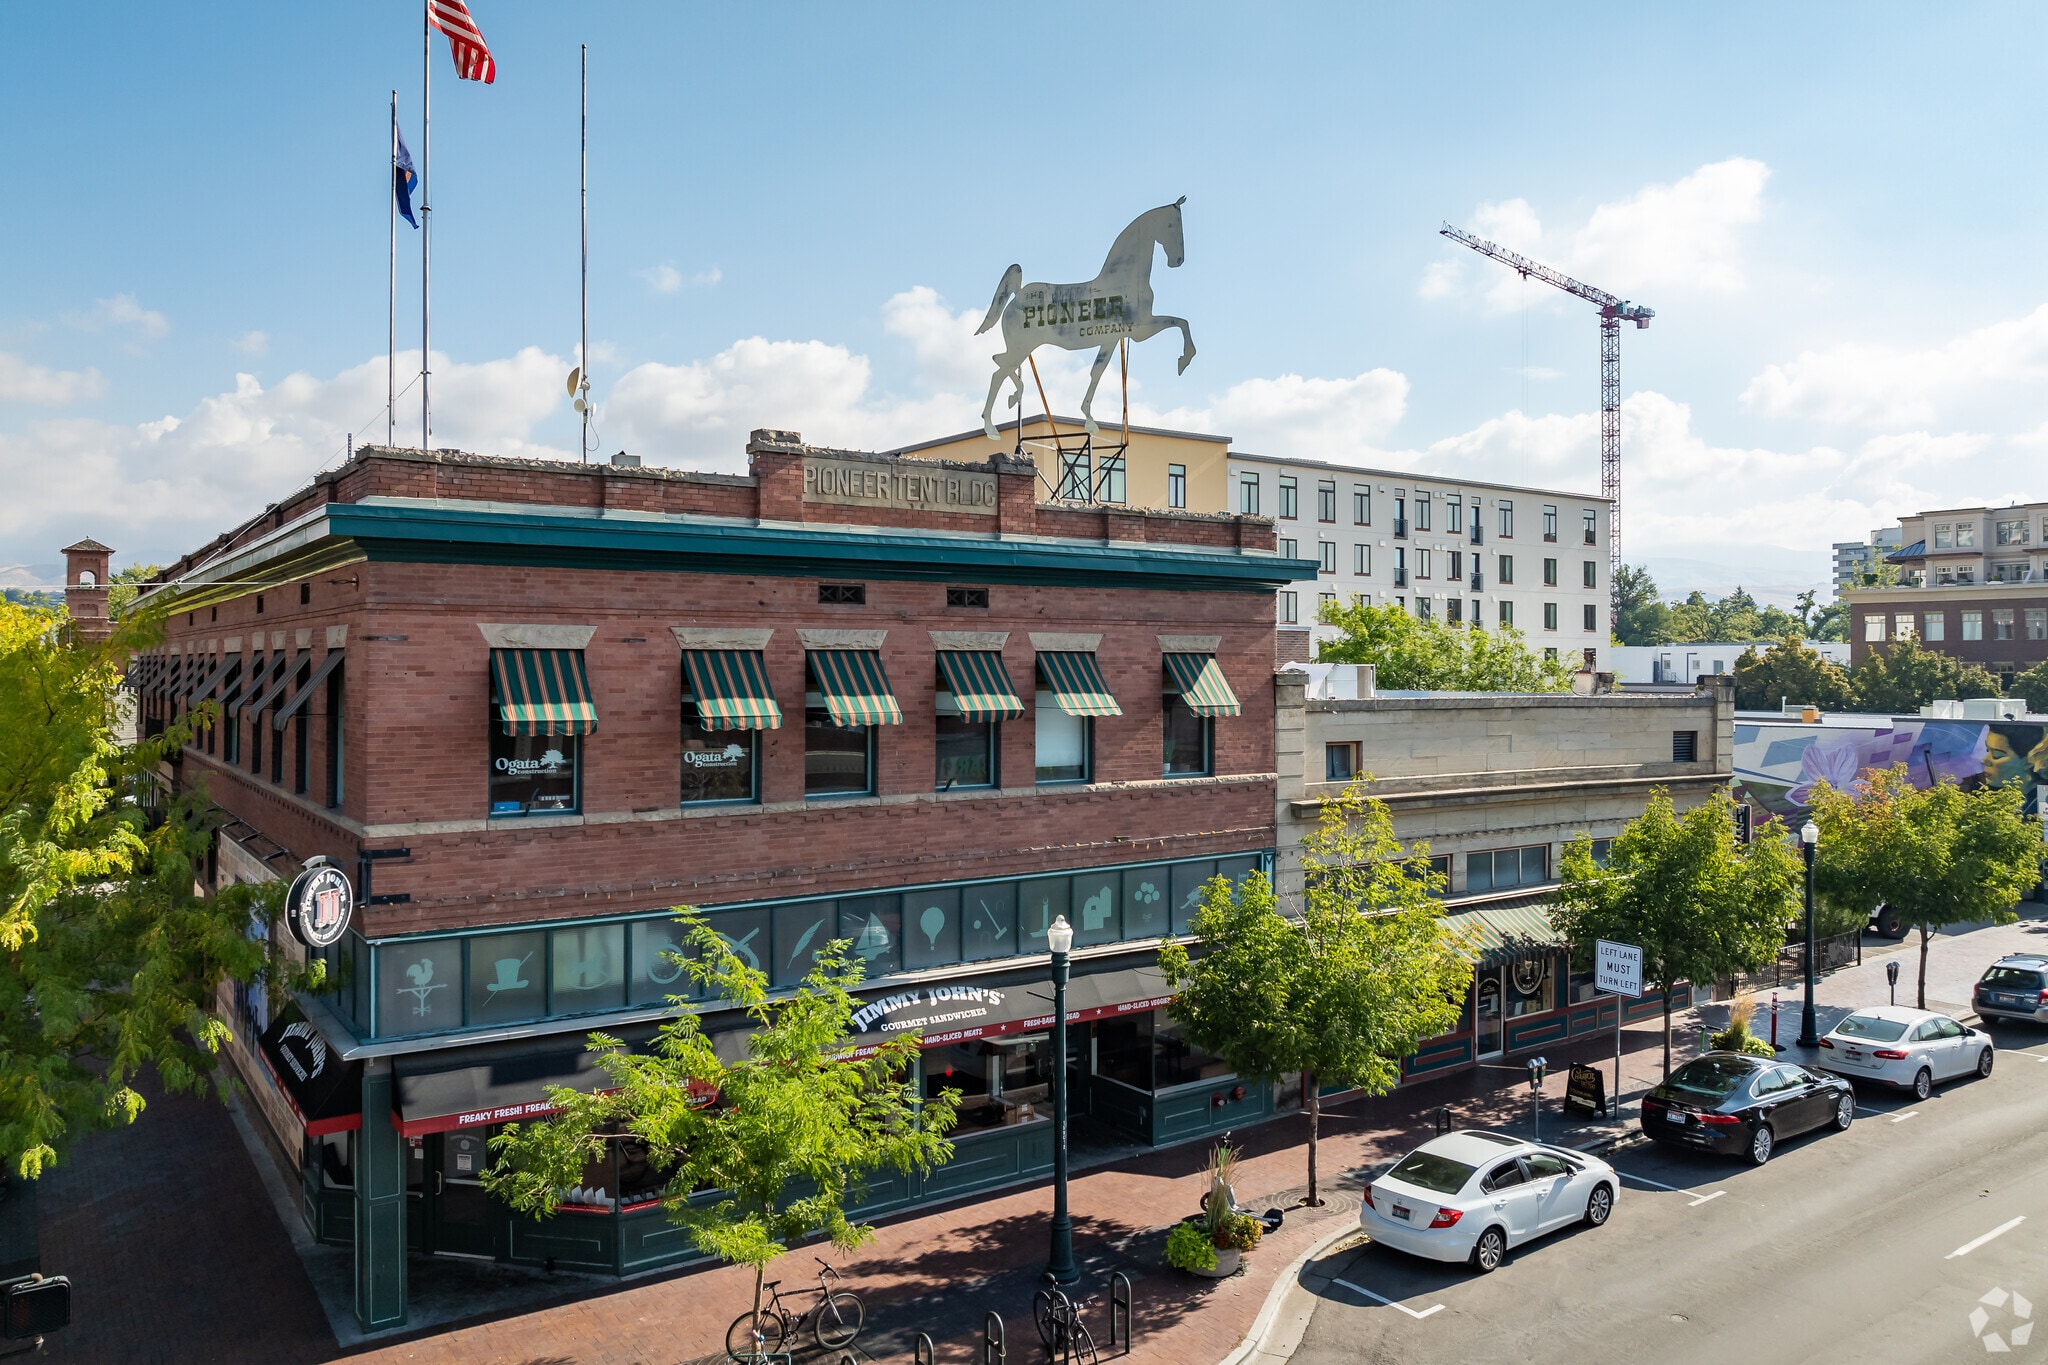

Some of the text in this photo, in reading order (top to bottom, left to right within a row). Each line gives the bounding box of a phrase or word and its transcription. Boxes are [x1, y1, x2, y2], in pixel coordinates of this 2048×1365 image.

[1022, 295, 1126, 329] PIONEER
[1079, 322, 1135, 337] COMPANY
[803, 465, 890, 500] PIONEER
[893, 473, 944, 504] TENT
[495, 757, 540, 775] Ogata
[684, 751, 723, 768] Ogata
[1600, 946, 1638, 962] LEFT LANE
[1606, 961, 1631, 975] MUST
[1599, 974, 1638, 991] TURN LEFT
[851, 985, 1002, 1033] JIMMY JOHN'S
[880, 1007, 988, 1032] GOURMET SANDWICHES
[924, 1031, 963, 1045] HAND-SLICED
[963, 1027, 983, 1038] MEATS
[1023, 1015, 1056, 1028] FRESH-BAKE
[1065, 1012, 1080, 1021] READ
[1117, 1000, 1150, 1012] HAND-SLICED
[459, 1111, 493, 1125] FREAKY
[494, 1105, 523, 1119] FRESH!
